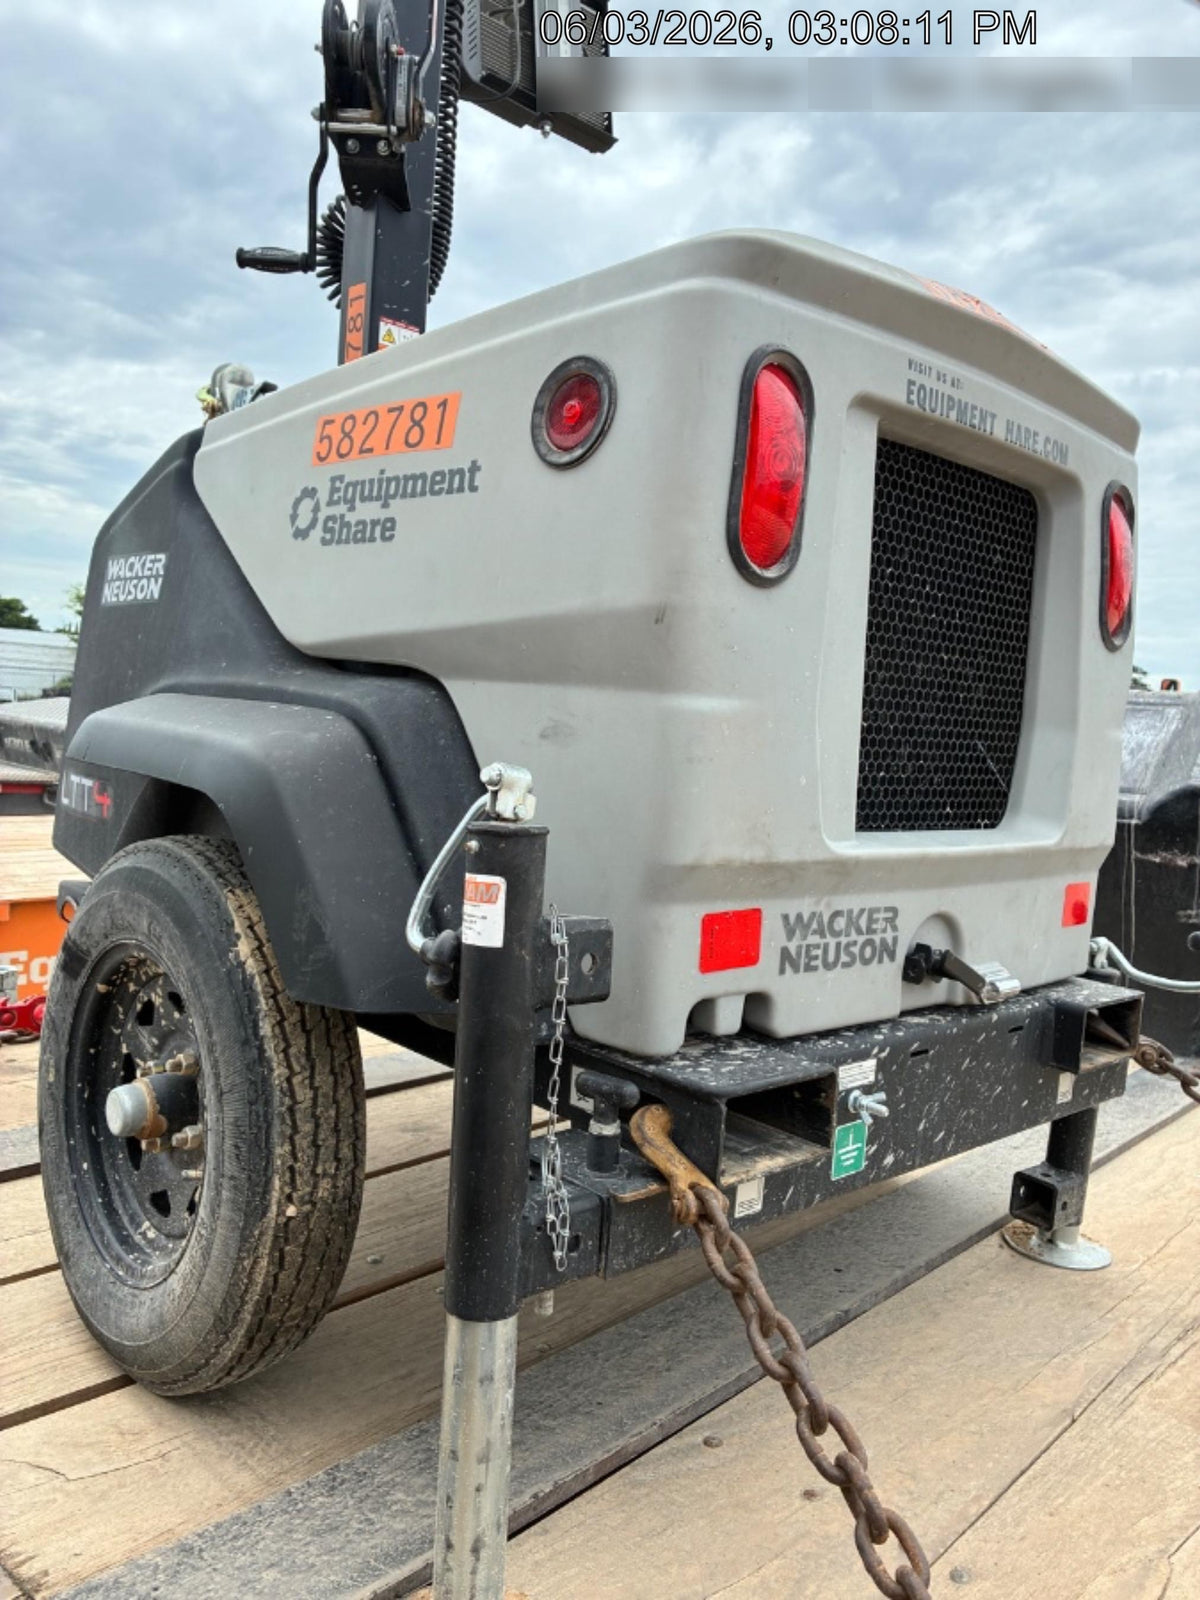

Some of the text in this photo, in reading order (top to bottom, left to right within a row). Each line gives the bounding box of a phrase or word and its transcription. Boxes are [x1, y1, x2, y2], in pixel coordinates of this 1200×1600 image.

[907, 358, 933, 378] VISIT
[936, 369, 948, 385] US
[906, 379, 998, 437] EQUIPMENT
[315, 397, 450, 463] 582781
[325, 459, 482, 513] Equipment
[320, 513, 397, 547] Share
[107, 553, 166, 580] WACKER
[102, 577, 163, 604] NEUSON
[781, 906, 899, 942] WACKER
[778, 935, 899, 976] NEUSON
